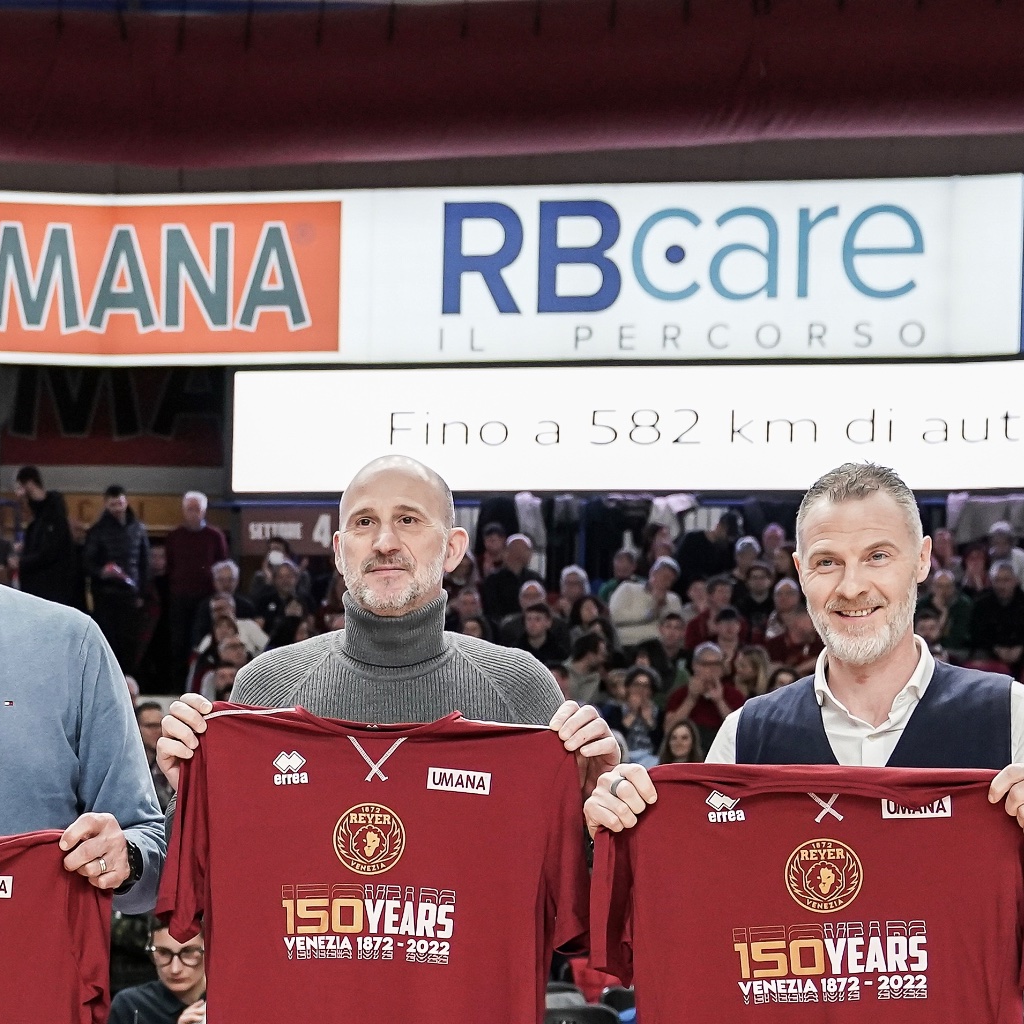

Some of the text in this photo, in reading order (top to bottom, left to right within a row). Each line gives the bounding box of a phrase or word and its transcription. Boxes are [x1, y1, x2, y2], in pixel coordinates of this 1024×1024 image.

[441, 199, 925, 314] RBcare
[439, 320, 926, 352] IL PERCORSO
[389, 407, 1021, 446] Fino a 582 km di aut
[312, 513, 331, 548] 4
[274, 771, 309, 785] errea
[432, 771, 486, 791] UMANA
[349, 813, 391, 825] REYER
[708, 809, 745, 823] errea
[800, 848, 845, 861] REYER
[350, 861, 387, 872] VENEZIA
[806, 899, 844, 910] VENEZIA
[284, 936, 352, 953] VENEZIA
[356, 937, 394, 953] 1872
[406, 940, 451, 957] 2022
[738, 978, 815, 996] VENEZIA
[820, 977, 860, 993] 1872
[877, 975, 927, 992] 2022
